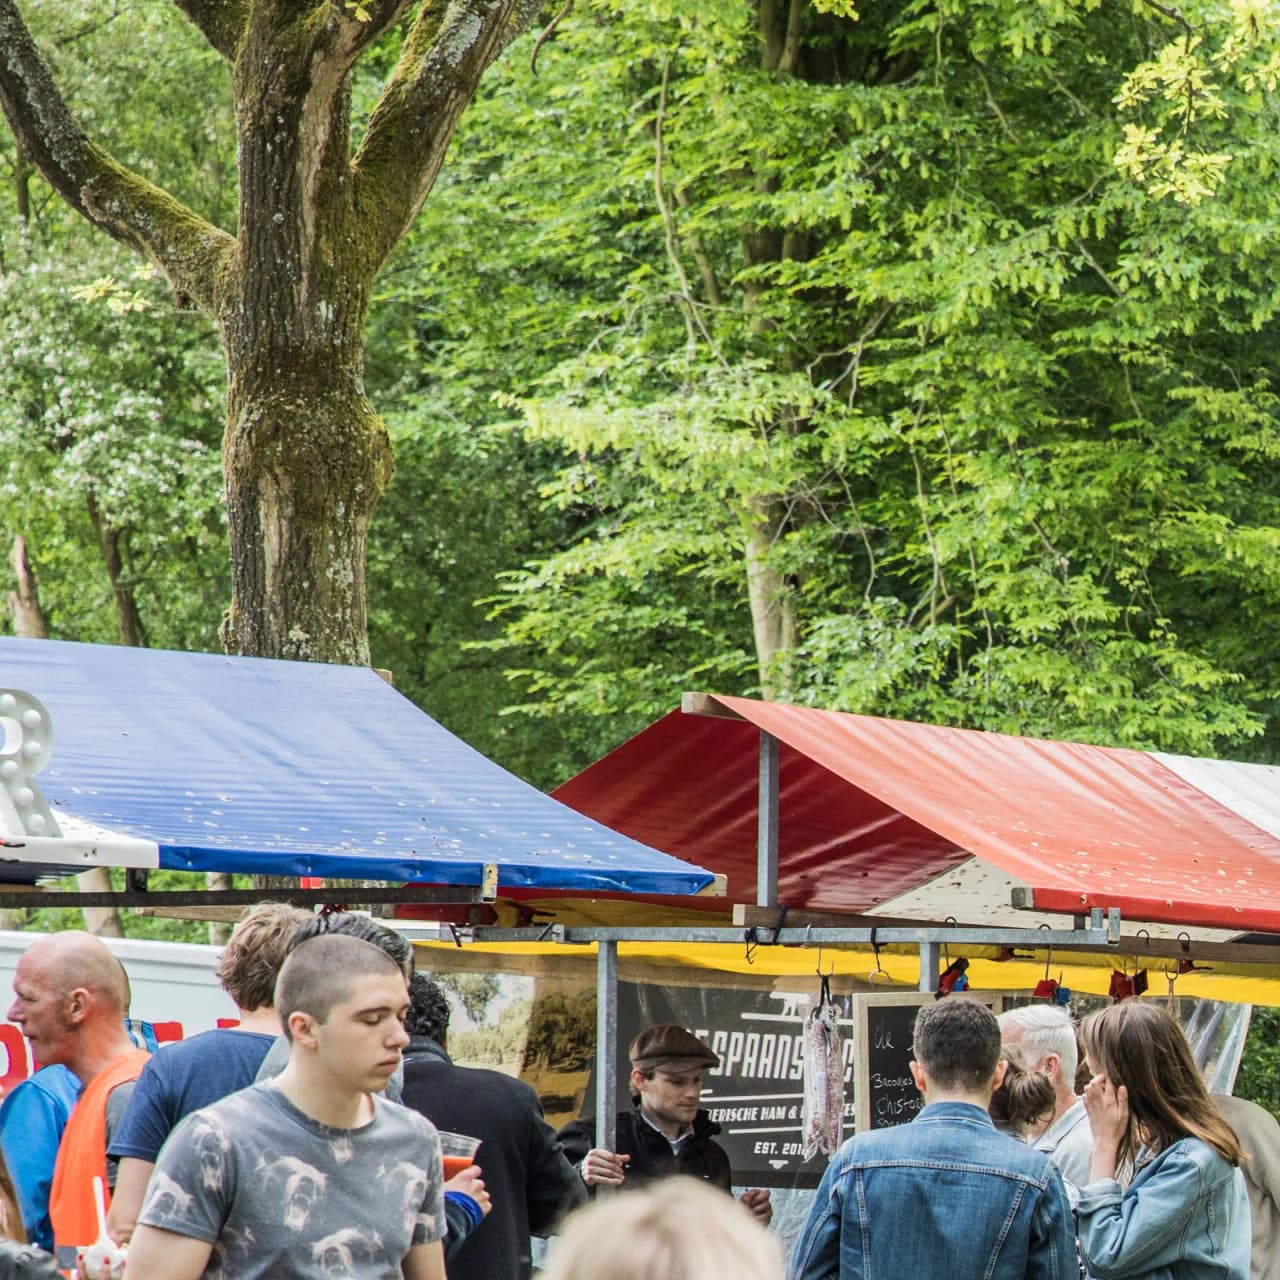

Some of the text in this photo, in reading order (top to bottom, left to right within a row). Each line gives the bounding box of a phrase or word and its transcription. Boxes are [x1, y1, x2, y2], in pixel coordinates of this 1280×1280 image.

[707, 1107, 758, 1122] ERISCHE
[760, 1105, 786, 1121] HAM
[788, 1105, 798, 1120] &
[754, 1141, 779, 1155] EST.
